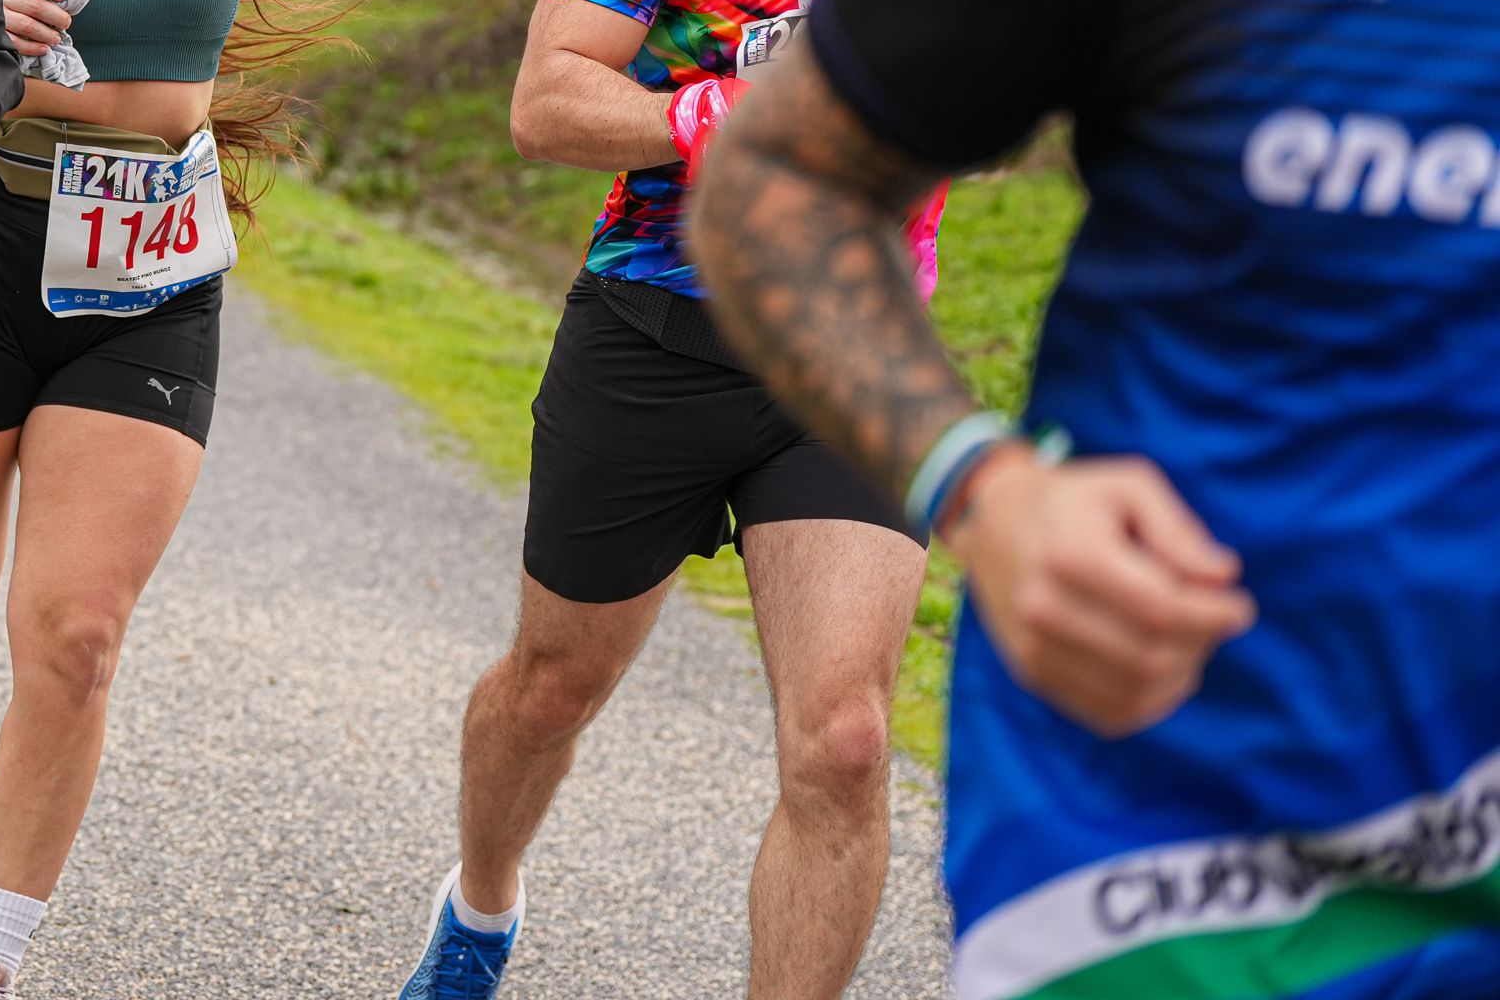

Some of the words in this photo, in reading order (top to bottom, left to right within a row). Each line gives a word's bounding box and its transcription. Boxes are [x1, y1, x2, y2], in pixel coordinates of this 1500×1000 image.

[62, 167, 73, 193] MEDIA
[71, 154, 85, 194] MARATÓN
[83, 156, 150, 201] 21K
[80, 192, 199, 270] 1148
[141, 271, 152, 279] PINO
